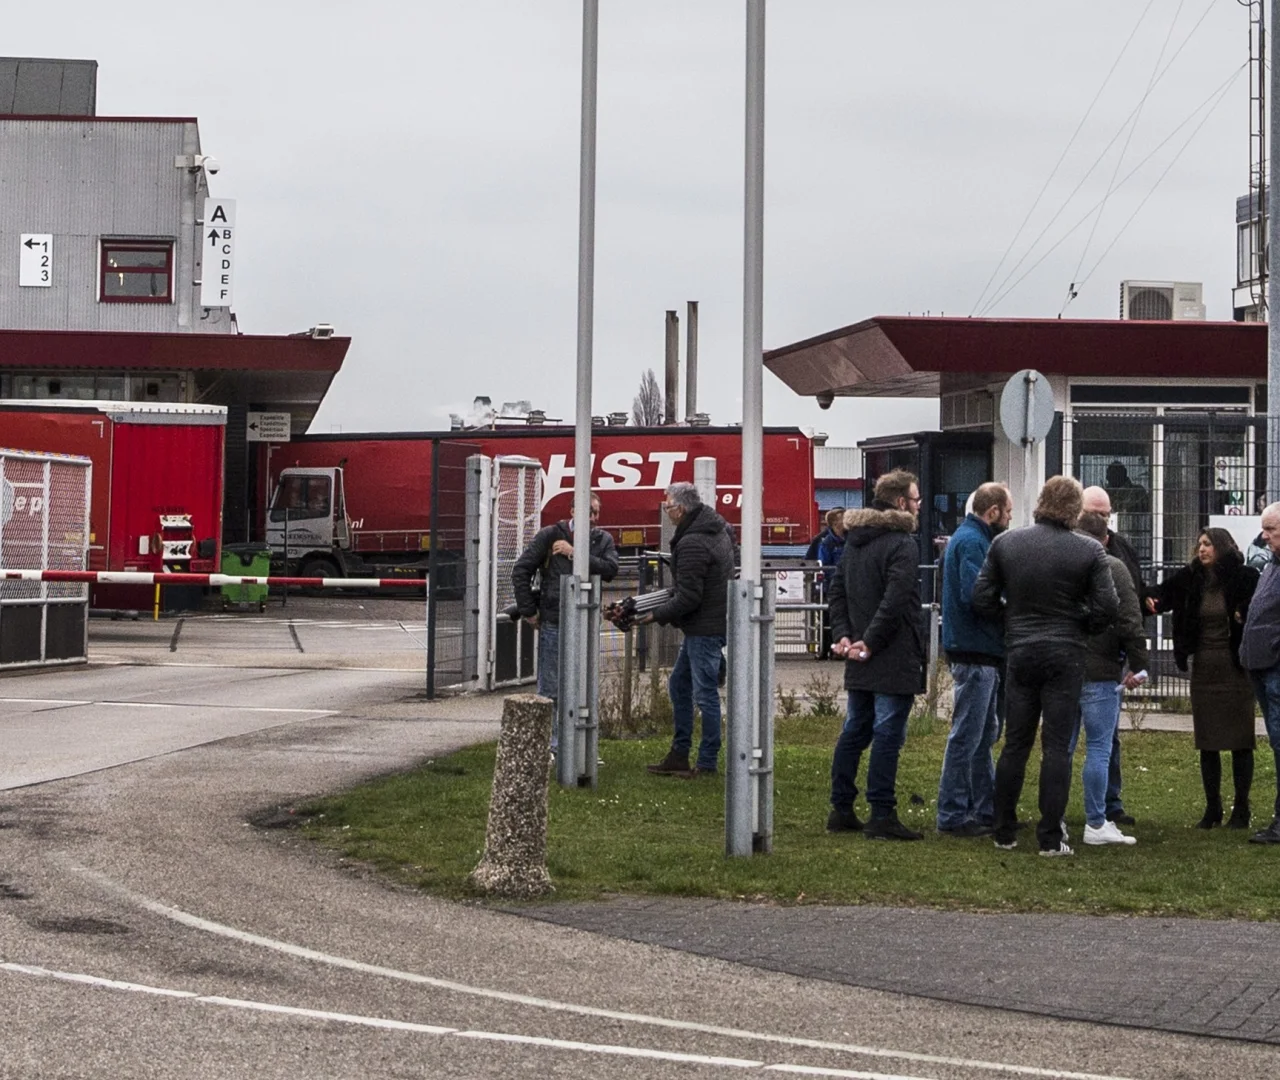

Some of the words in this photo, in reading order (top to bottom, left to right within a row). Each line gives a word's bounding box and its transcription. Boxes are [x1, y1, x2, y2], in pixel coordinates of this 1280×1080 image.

[210, 205, 227, 223] A
[222, 229, 232, 240] B
[41, 241, 49, 253] 1
[222, 244, 231, 255] C
[40, 255, 49, 267] 2
[221, 259, 230, 270] D
[40, 269, 49, 282] 3
[221, 274, 229, 285] E
[220, 289, 228, 299] F
[548, 451, 688, 489] HST
